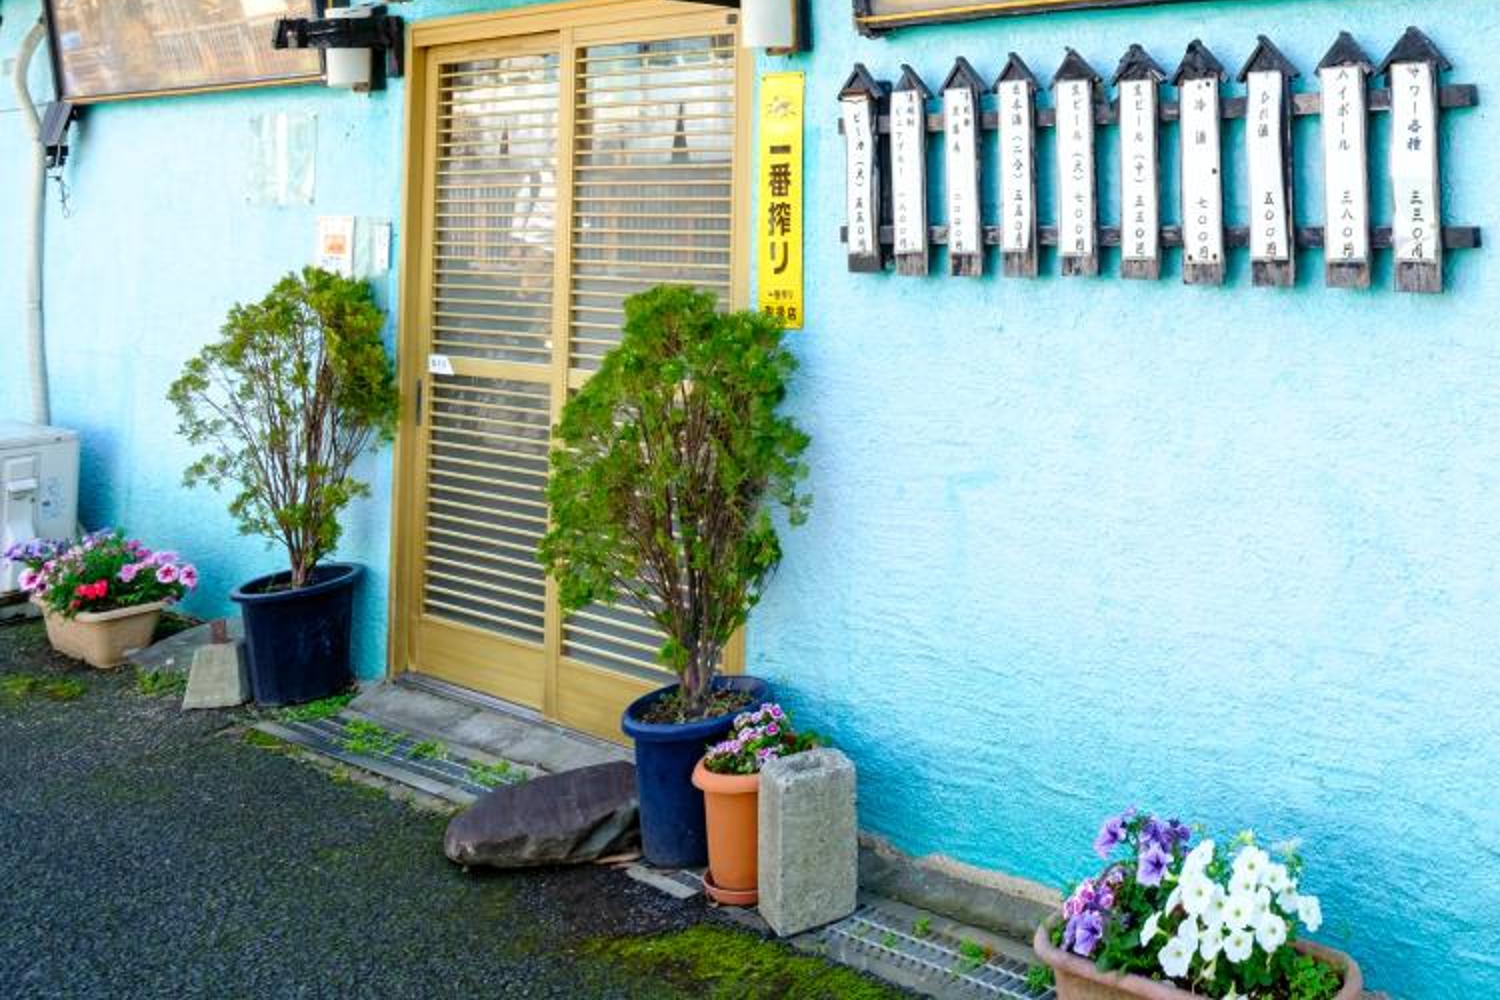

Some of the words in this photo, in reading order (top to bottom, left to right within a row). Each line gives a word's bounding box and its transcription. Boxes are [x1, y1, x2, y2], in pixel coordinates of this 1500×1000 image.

[1336, 70, 1351, 151] ハイボール
[767, 144, 793, 276] 一番搾り
